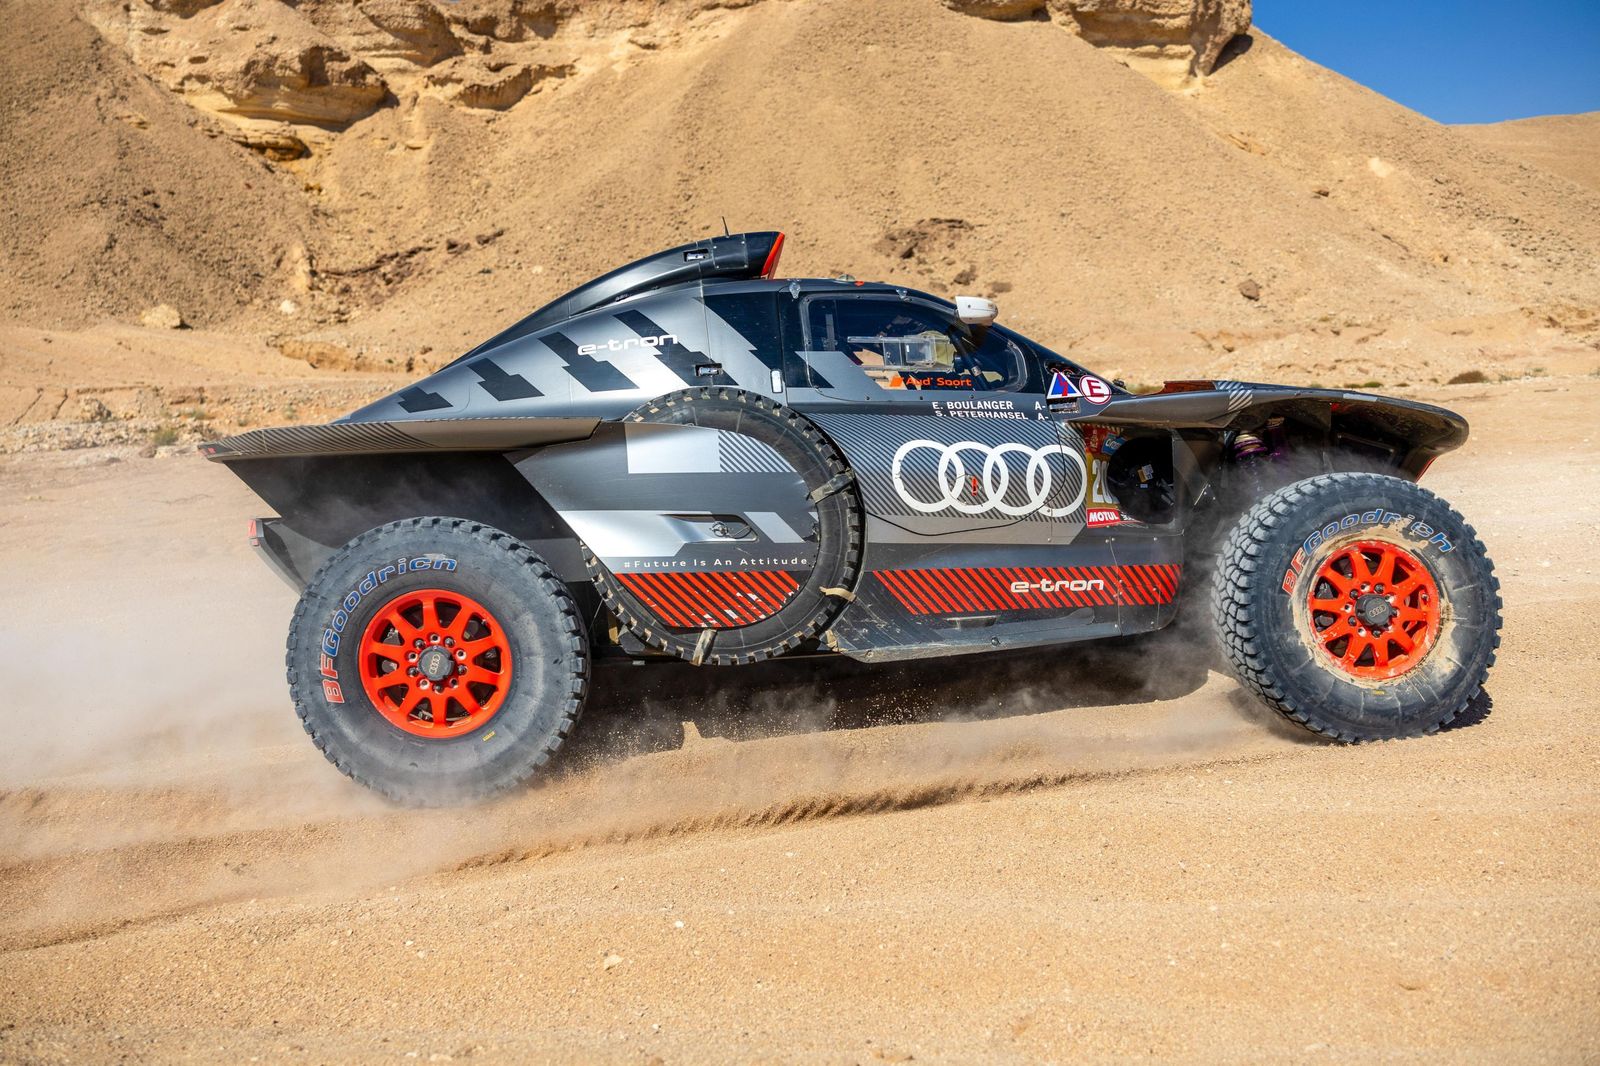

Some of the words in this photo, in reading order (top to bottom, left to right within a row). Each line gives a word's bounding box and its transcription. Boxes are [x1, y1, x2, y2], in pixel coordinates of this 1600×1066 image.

[577, 334, 678, 356] e-tron
[1086, 379, 1105, 397] E
[932, 401, 943, 410] E.
[947, 400, 1014, 410] BOULANGER
[950, 411, 1029, 420] PETERHANSEL
[1088, 511, 1119, 522] MOTUL
[1281, 508, 1454, 597] BFGoodrch
[624, 560, 686, 568] #Future
[694, 559, 706, 567] Is
[714, 558, 732, 566] An
[740, 557, 807, 566] Attitude
[1010, 578, 1105, 593] e-tron
